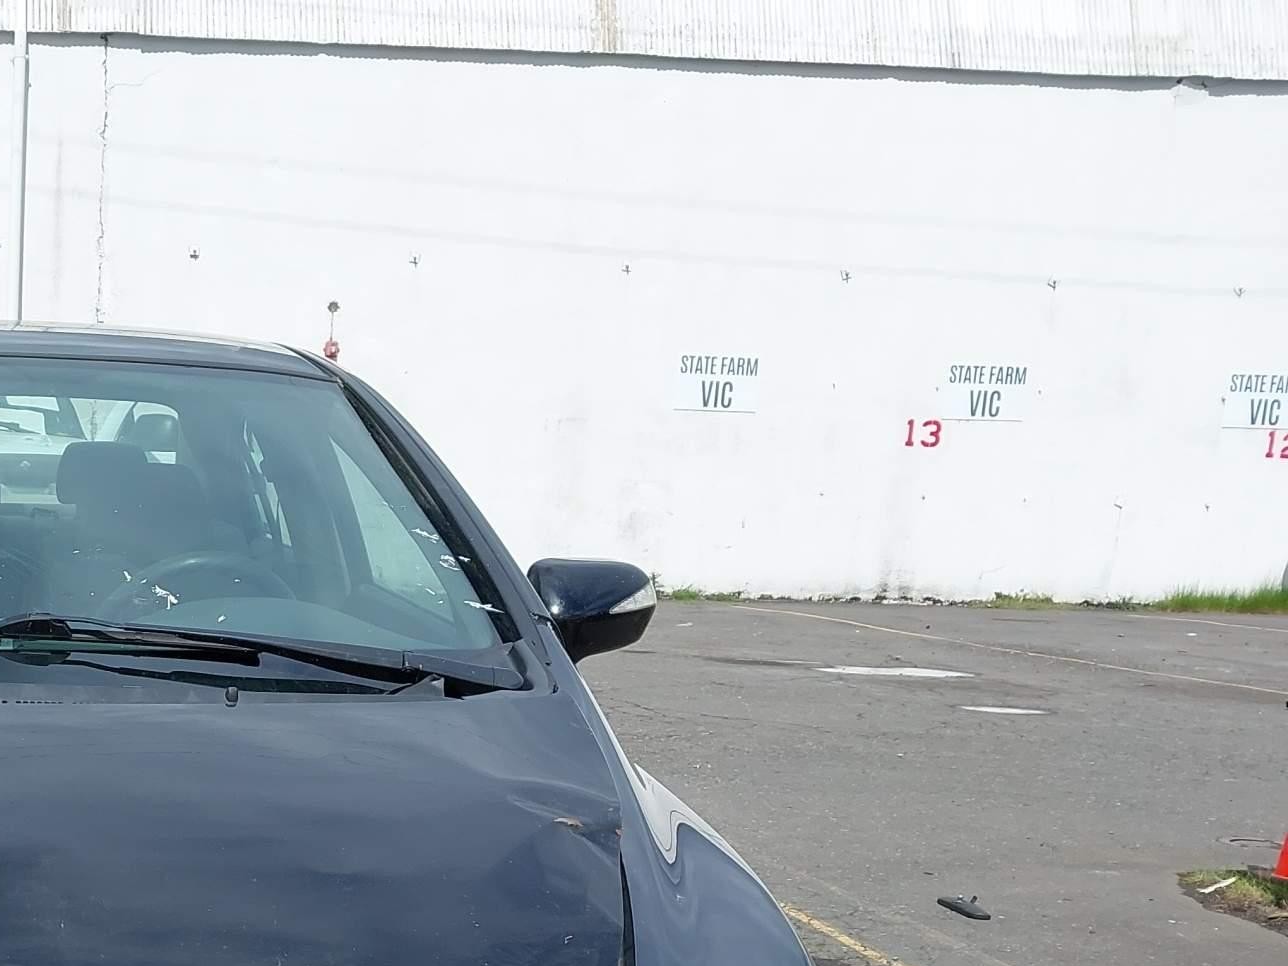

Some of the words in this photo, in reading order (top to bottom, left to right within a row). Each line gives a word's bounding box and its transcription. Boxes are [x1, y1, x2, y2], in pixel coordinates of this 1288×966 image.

[680, 355, 718, 375] STATE
[720, 357, 759, 376] FARM
[949, 365, 986, 384] STATE
[988, 366, 1028, 385] FARM
[701, 380, 733, 408] VIC
[1230, 374, 1268, 393] STATE
[969, 390, 1002, 418] VIC
[1250, 399, 1281, 426] VIC
[905, 418, 942, 448] 13
